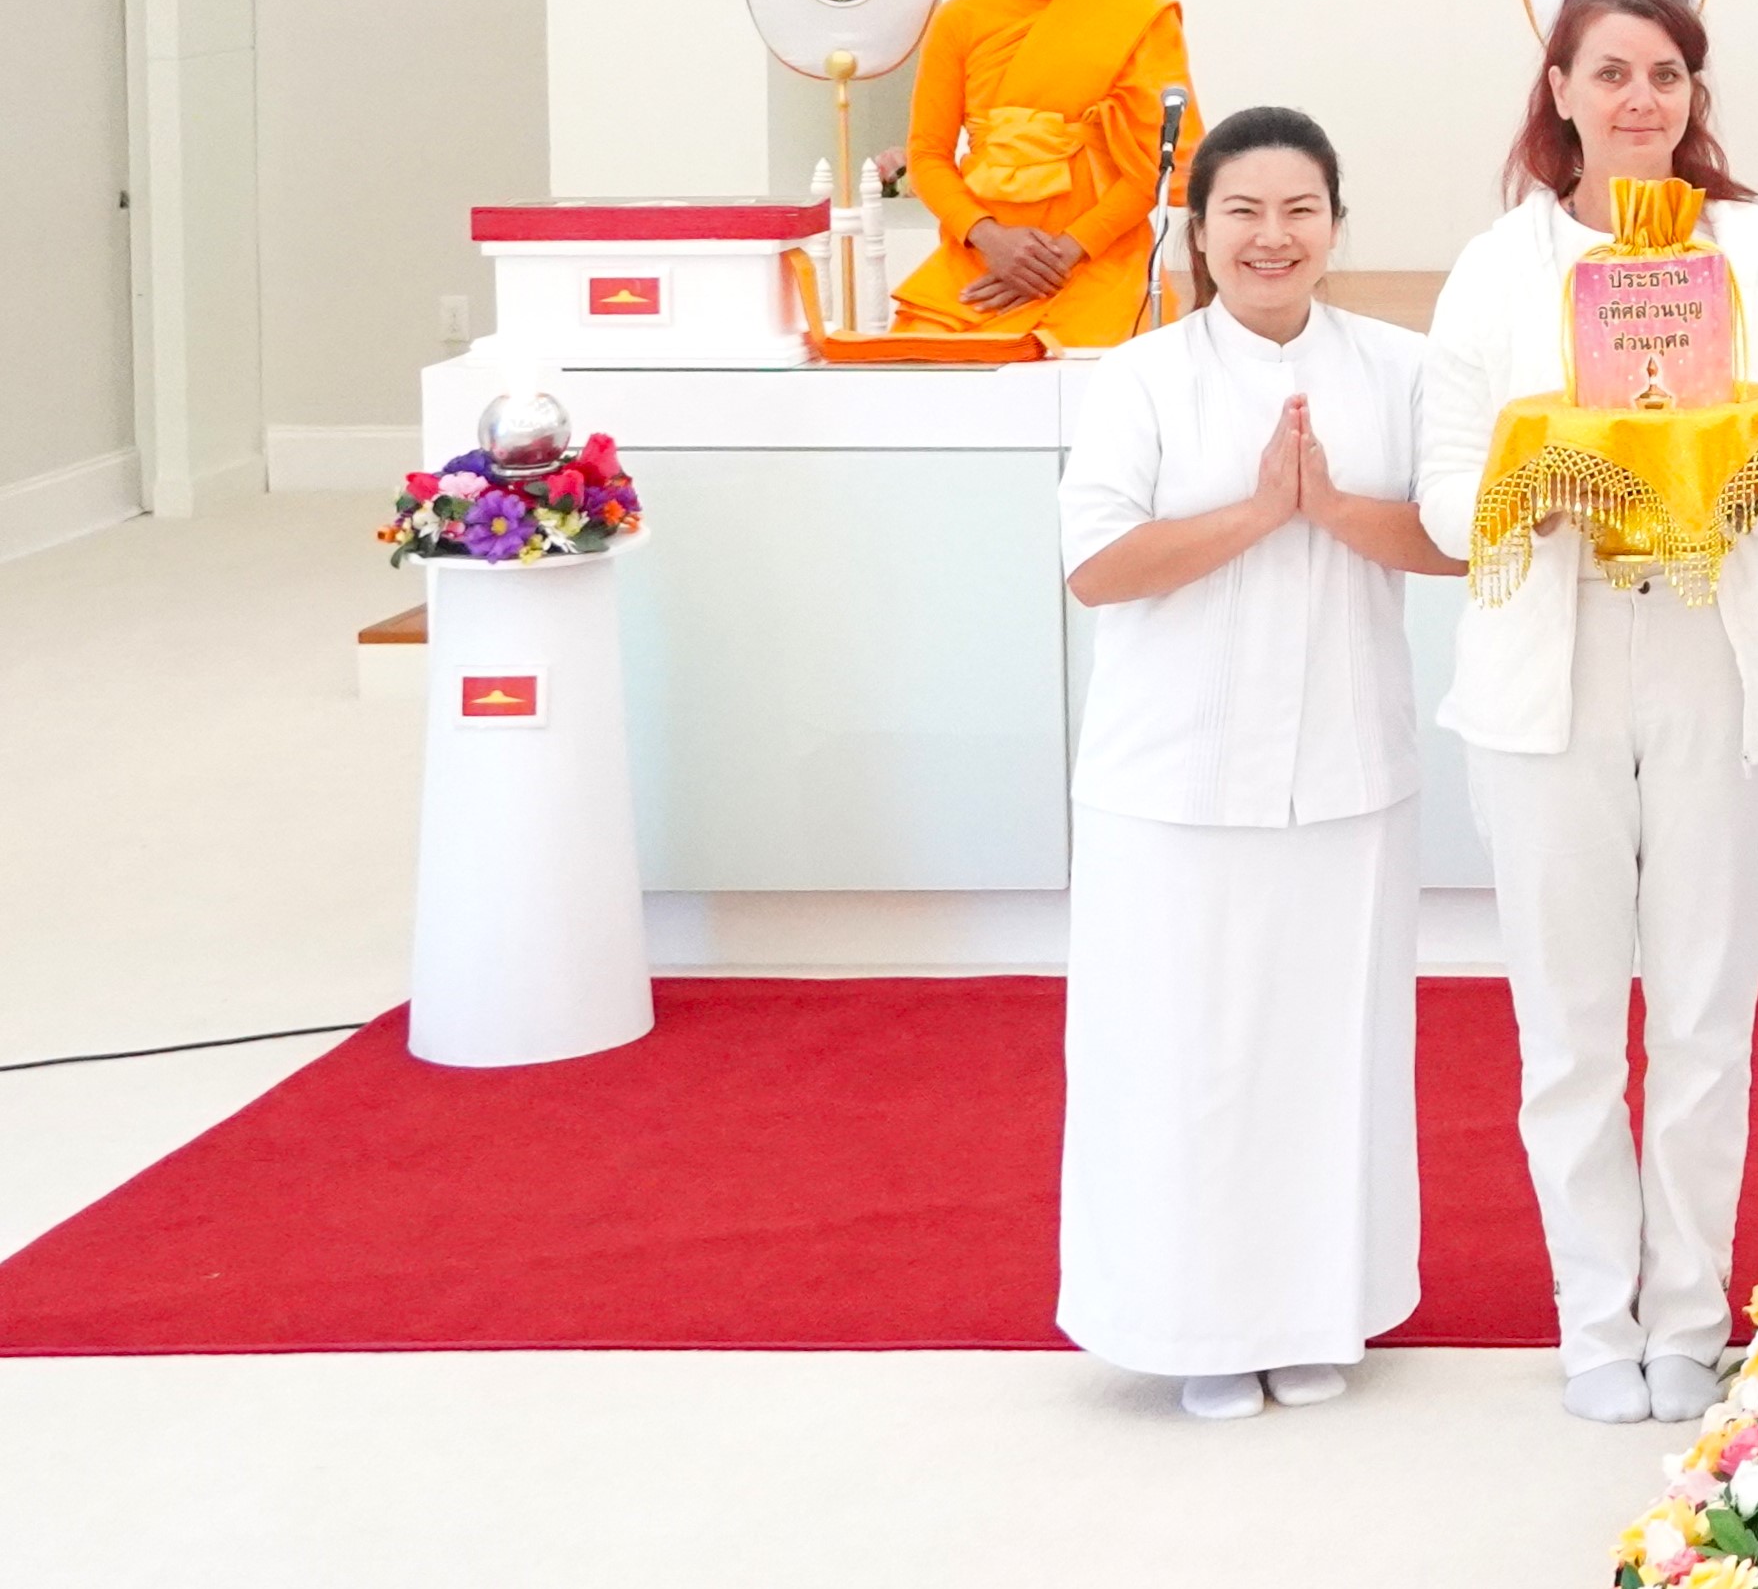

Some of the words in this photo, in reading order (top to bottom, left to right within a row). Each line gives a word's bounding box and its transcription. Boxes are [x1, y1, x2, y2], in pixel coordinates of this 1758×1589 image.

[1608, 269, 1690, 289] ประธาน
[1598, 300, 1703, 328] อุทิศส่วนบุญ
[1613, 331, 1690, 357] ส่วนกุศล
